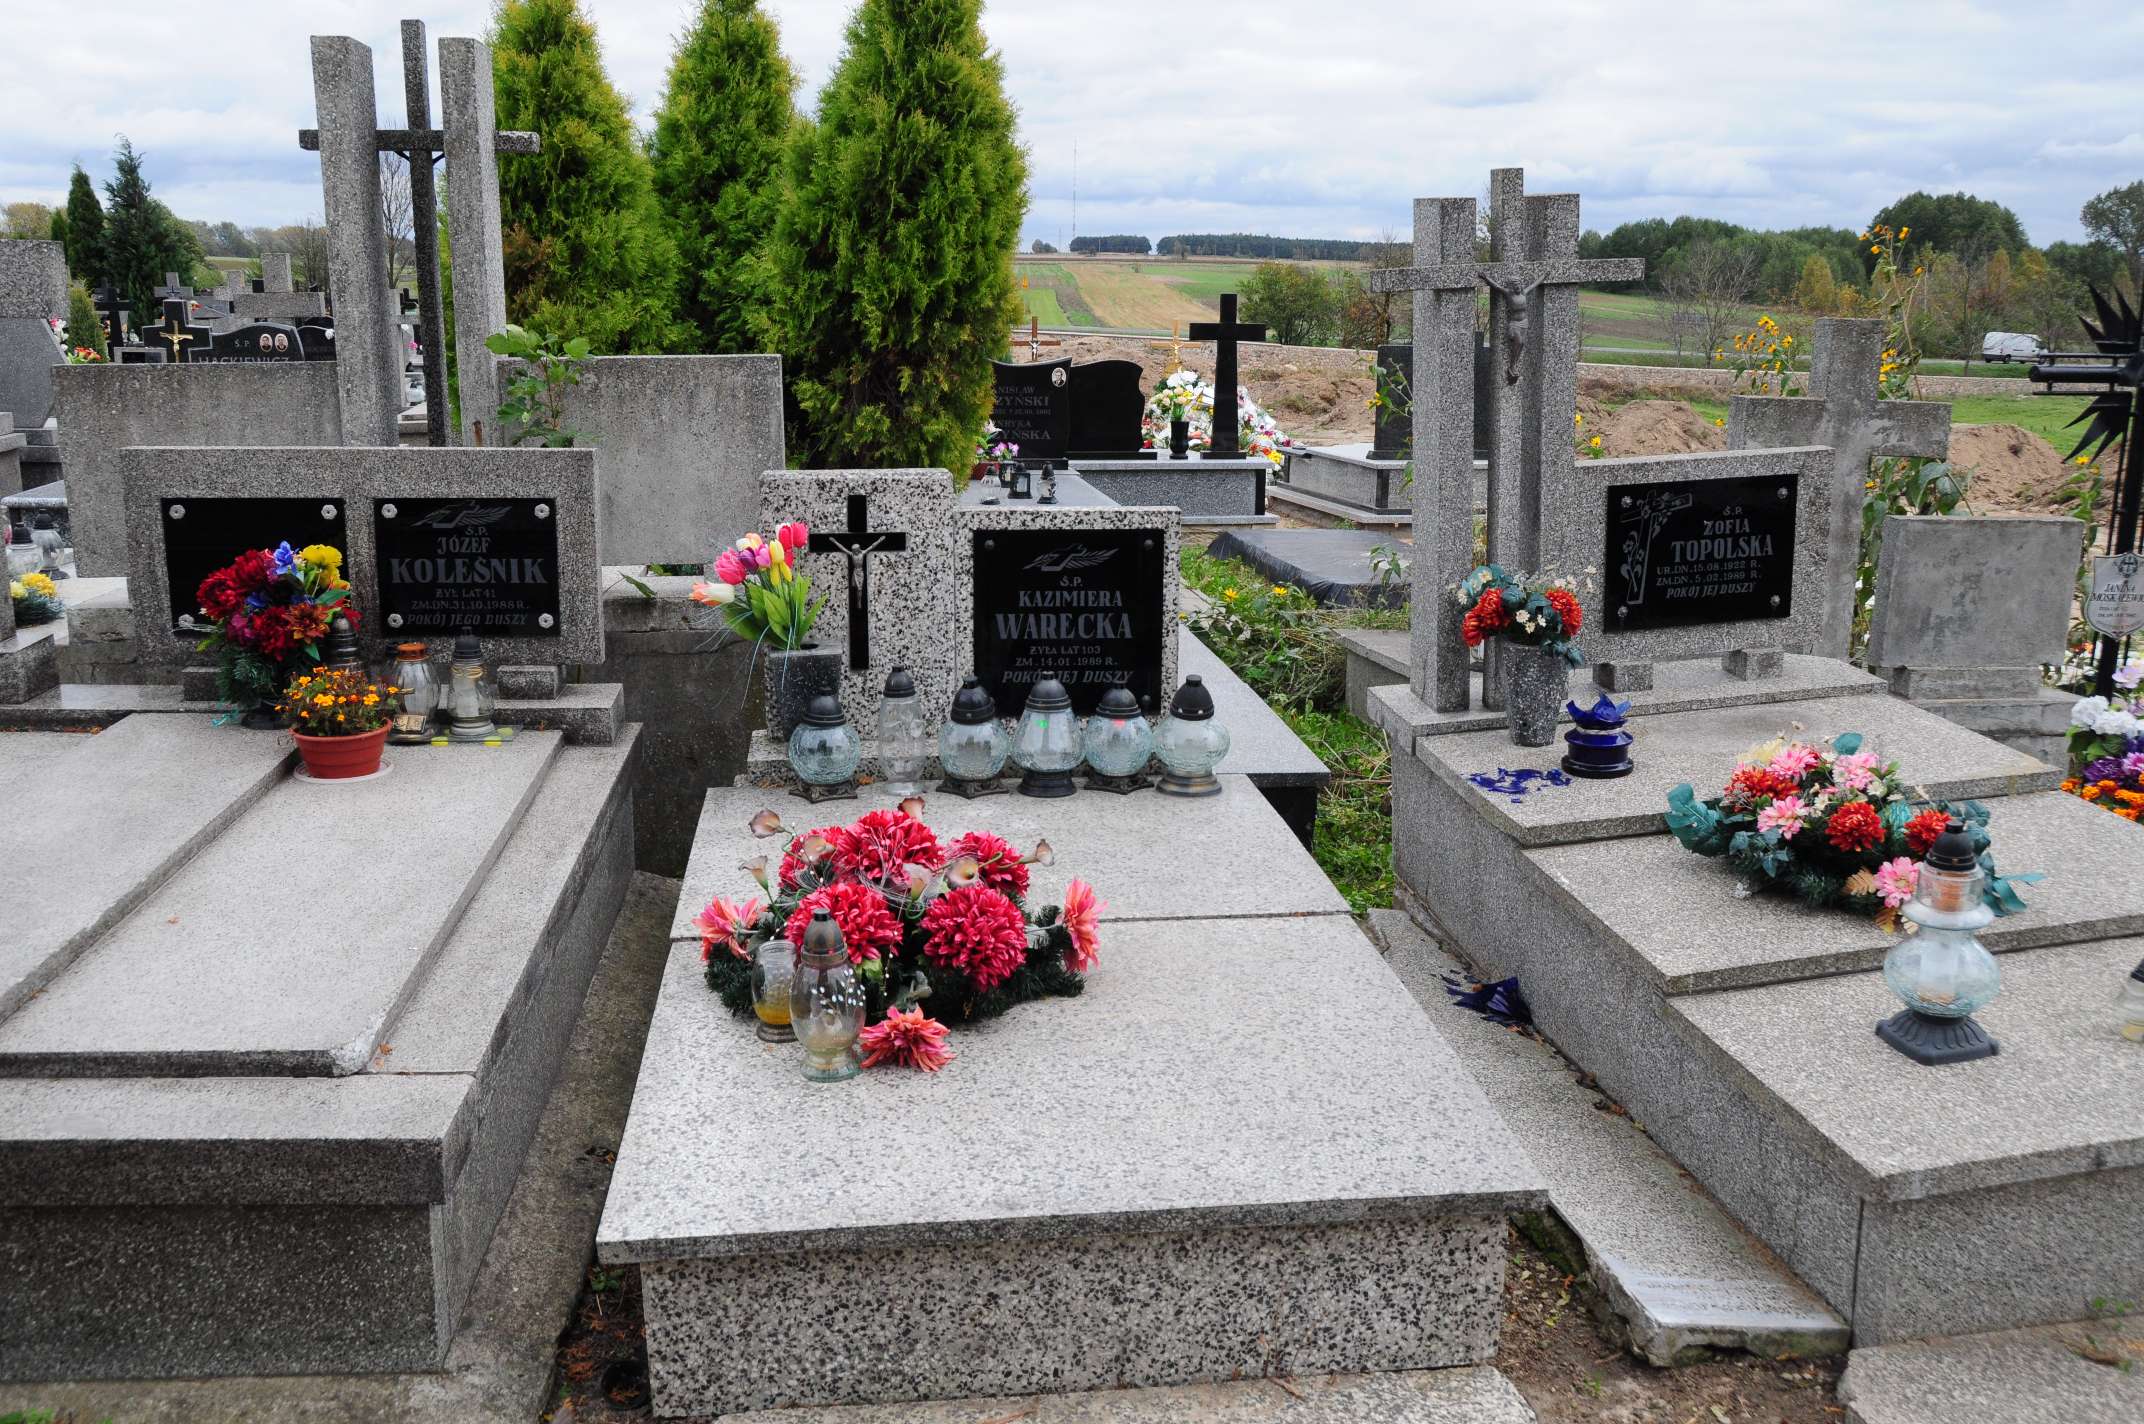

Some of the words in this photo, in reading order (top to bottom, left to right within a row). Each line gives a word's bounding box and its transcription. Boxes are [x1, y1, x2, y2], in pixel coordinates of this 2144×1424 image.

[1703, 518, 1750, 536] ZOFIA
[437, 535, 492, 555] JÓZEF
[1671, 534, 1773, 563] TOPOLSKA
[390, 556, 548, 584] KOLEŚNIK
[1019, 590, 1122, 607] KAZIMIERA
[406, 612, 446, 626] POKÓJ
[449, 614, 480, 626] JEGO
[484, 614, 528, 625] DUSZY
[995, 612, 1132, 640] WARECKA
[1060, 645, 1080, 655] LAT
[1083, 645, 1101, 654] 103
[1002, 668, 1047, 683] POKÓ
[1083, 670, 1134, 684] DUSZY
